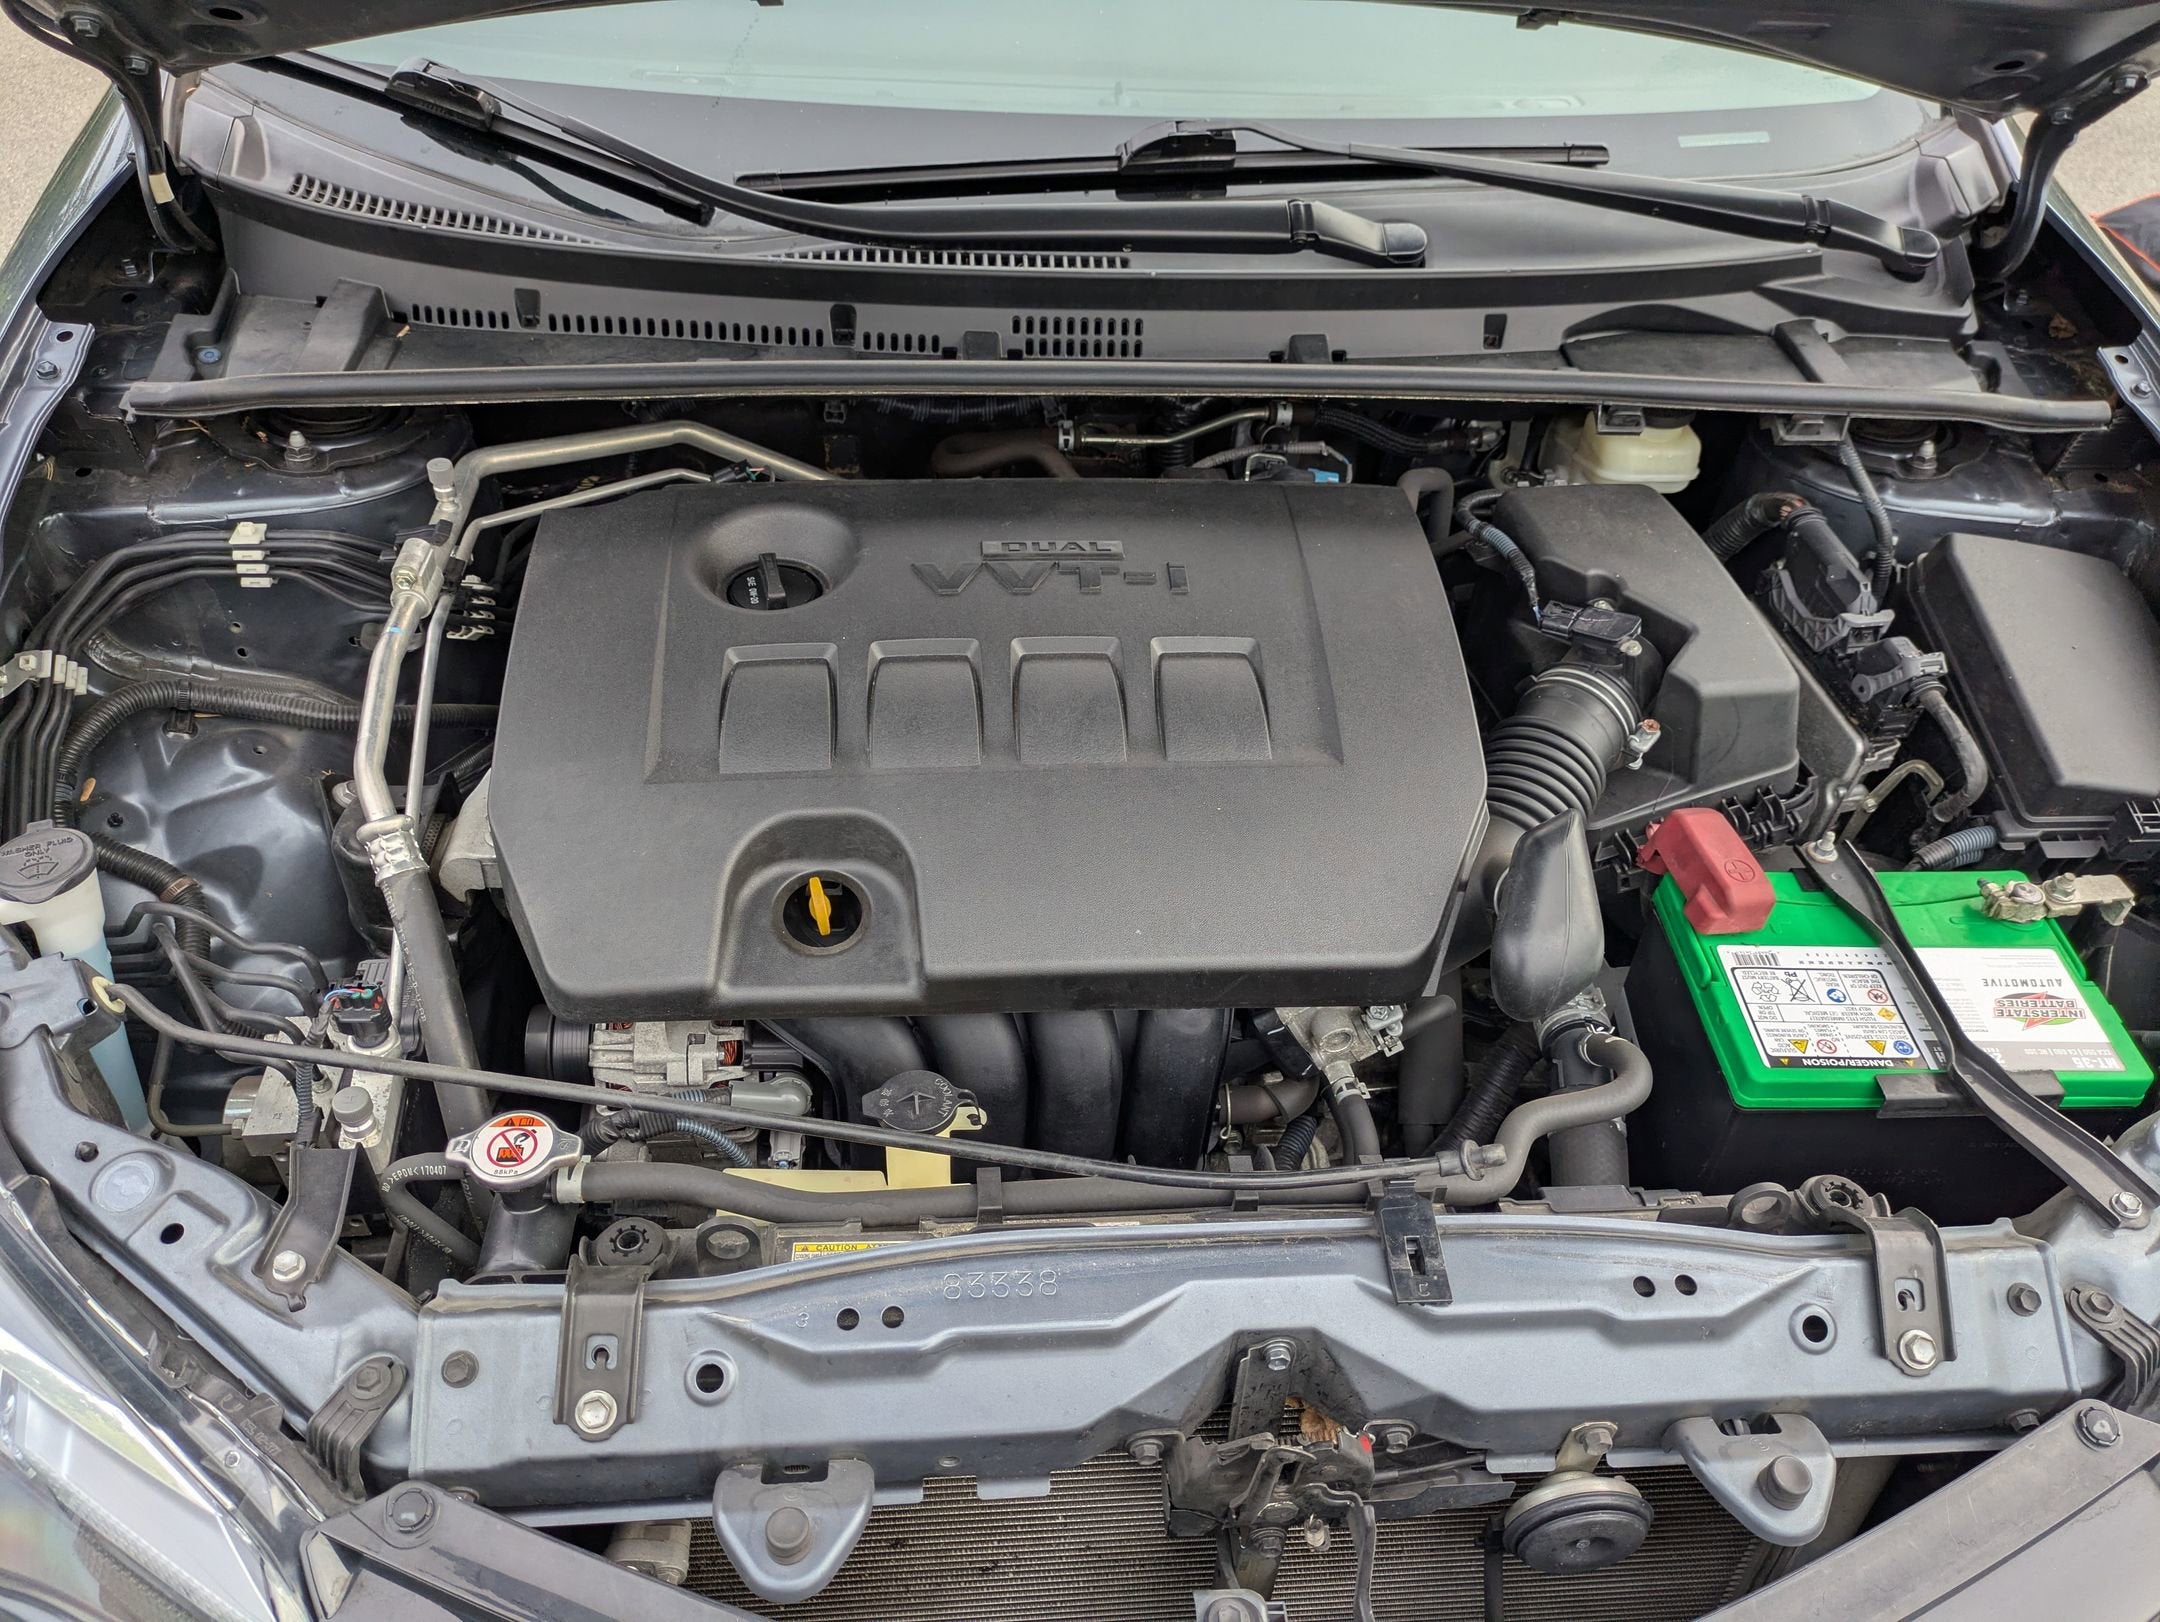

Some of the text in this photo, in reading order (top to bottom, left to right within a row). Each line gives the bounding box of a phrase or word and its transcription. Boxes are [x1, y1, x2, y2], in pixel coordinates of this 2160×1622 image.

[1000, 541, 1112, 552] DUAL
[1982, 978, 2062, 988] AUTOMOTIVE
[1996, 999, 2074, 1008] BATTERIES
[1996, 1008, 2084, 1018] INTERSTATE
[1802, 1058, 1893, 1067] DANGER/POISON
[2072, 1057, 2117, 1068] MT-35
[934, 1078, 953, 1118] COOLANT
[420, 1165, 446, 1176] 170407
[816, 1244, 858, 1252] CAUTION
[943, 1269, 1058, 1300] 83338
